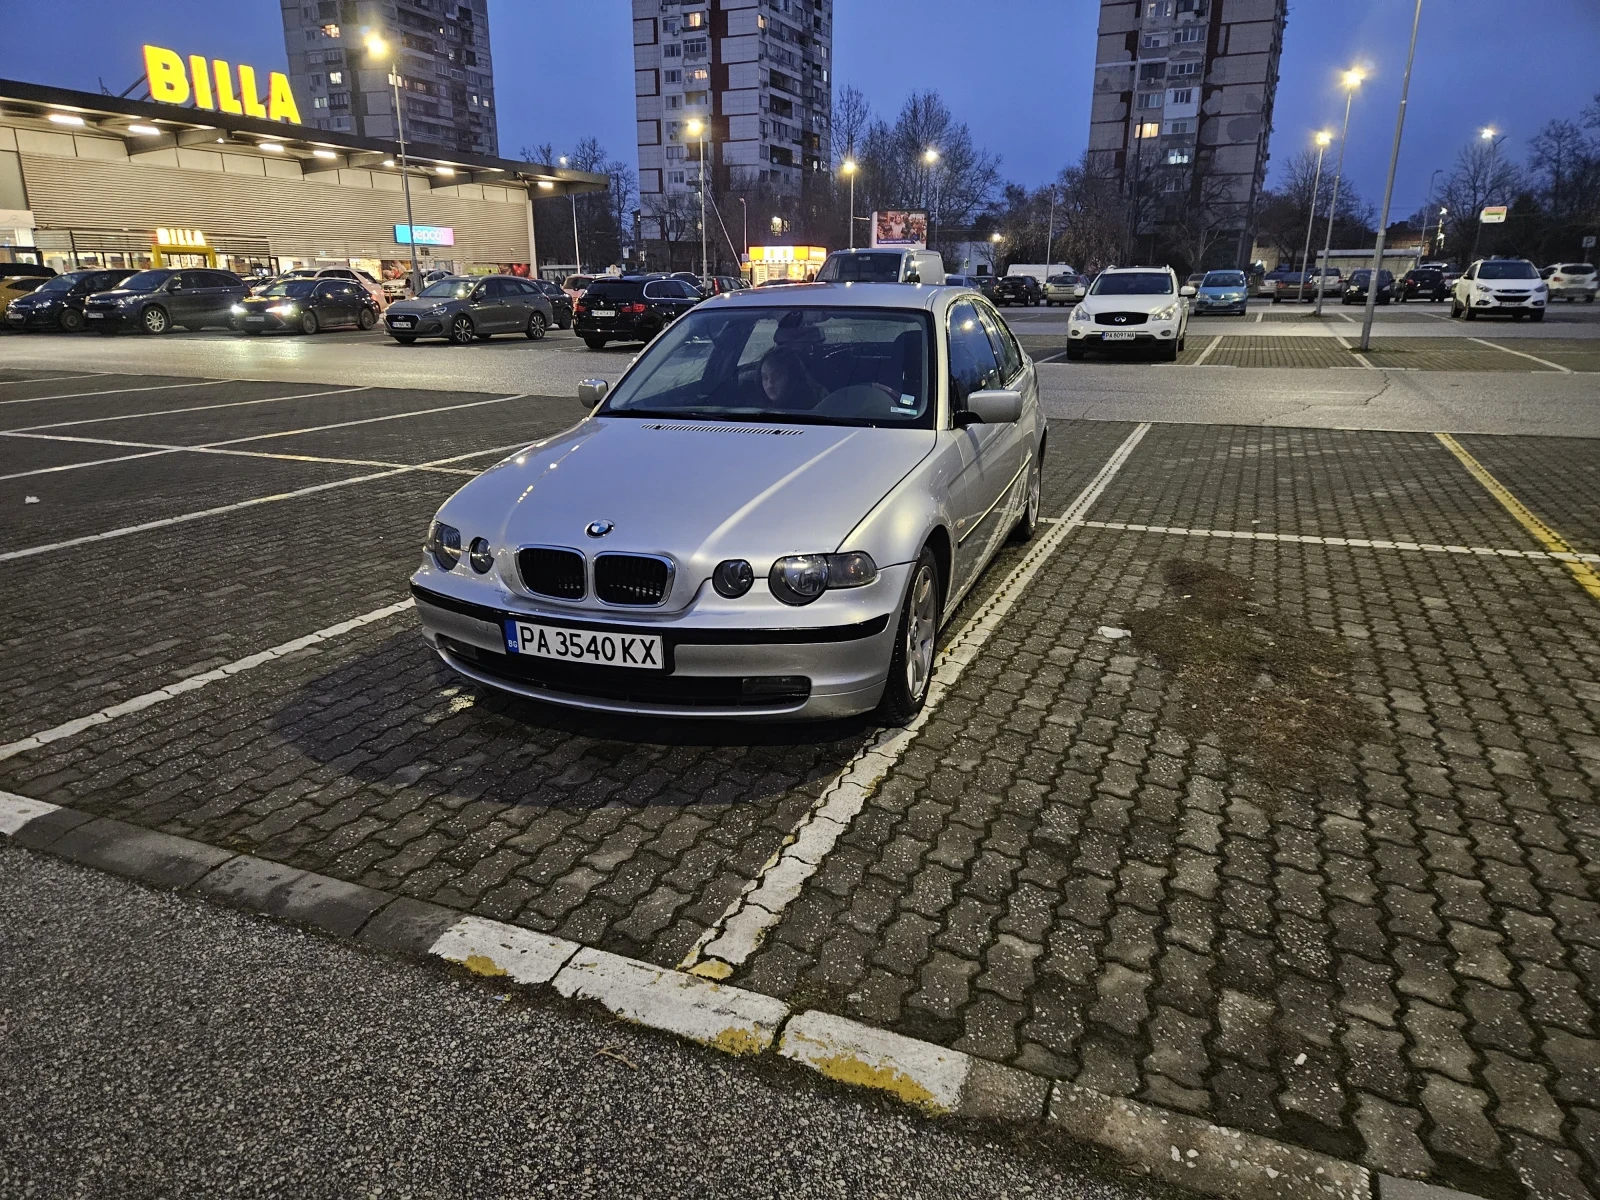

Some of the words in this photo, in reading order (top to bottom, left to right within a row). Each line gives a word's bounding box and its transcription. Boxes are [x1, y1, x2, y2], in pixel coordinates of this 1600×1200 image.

[142, 44, 302, 124] BILLA
[156, 228, 206, 246] BILLA
[508, 639, 518, 649] BG
[519, 626, 551, 655] PA
[555, 631, 616, 662] 3540
[620, 637, 658, 665] KX
